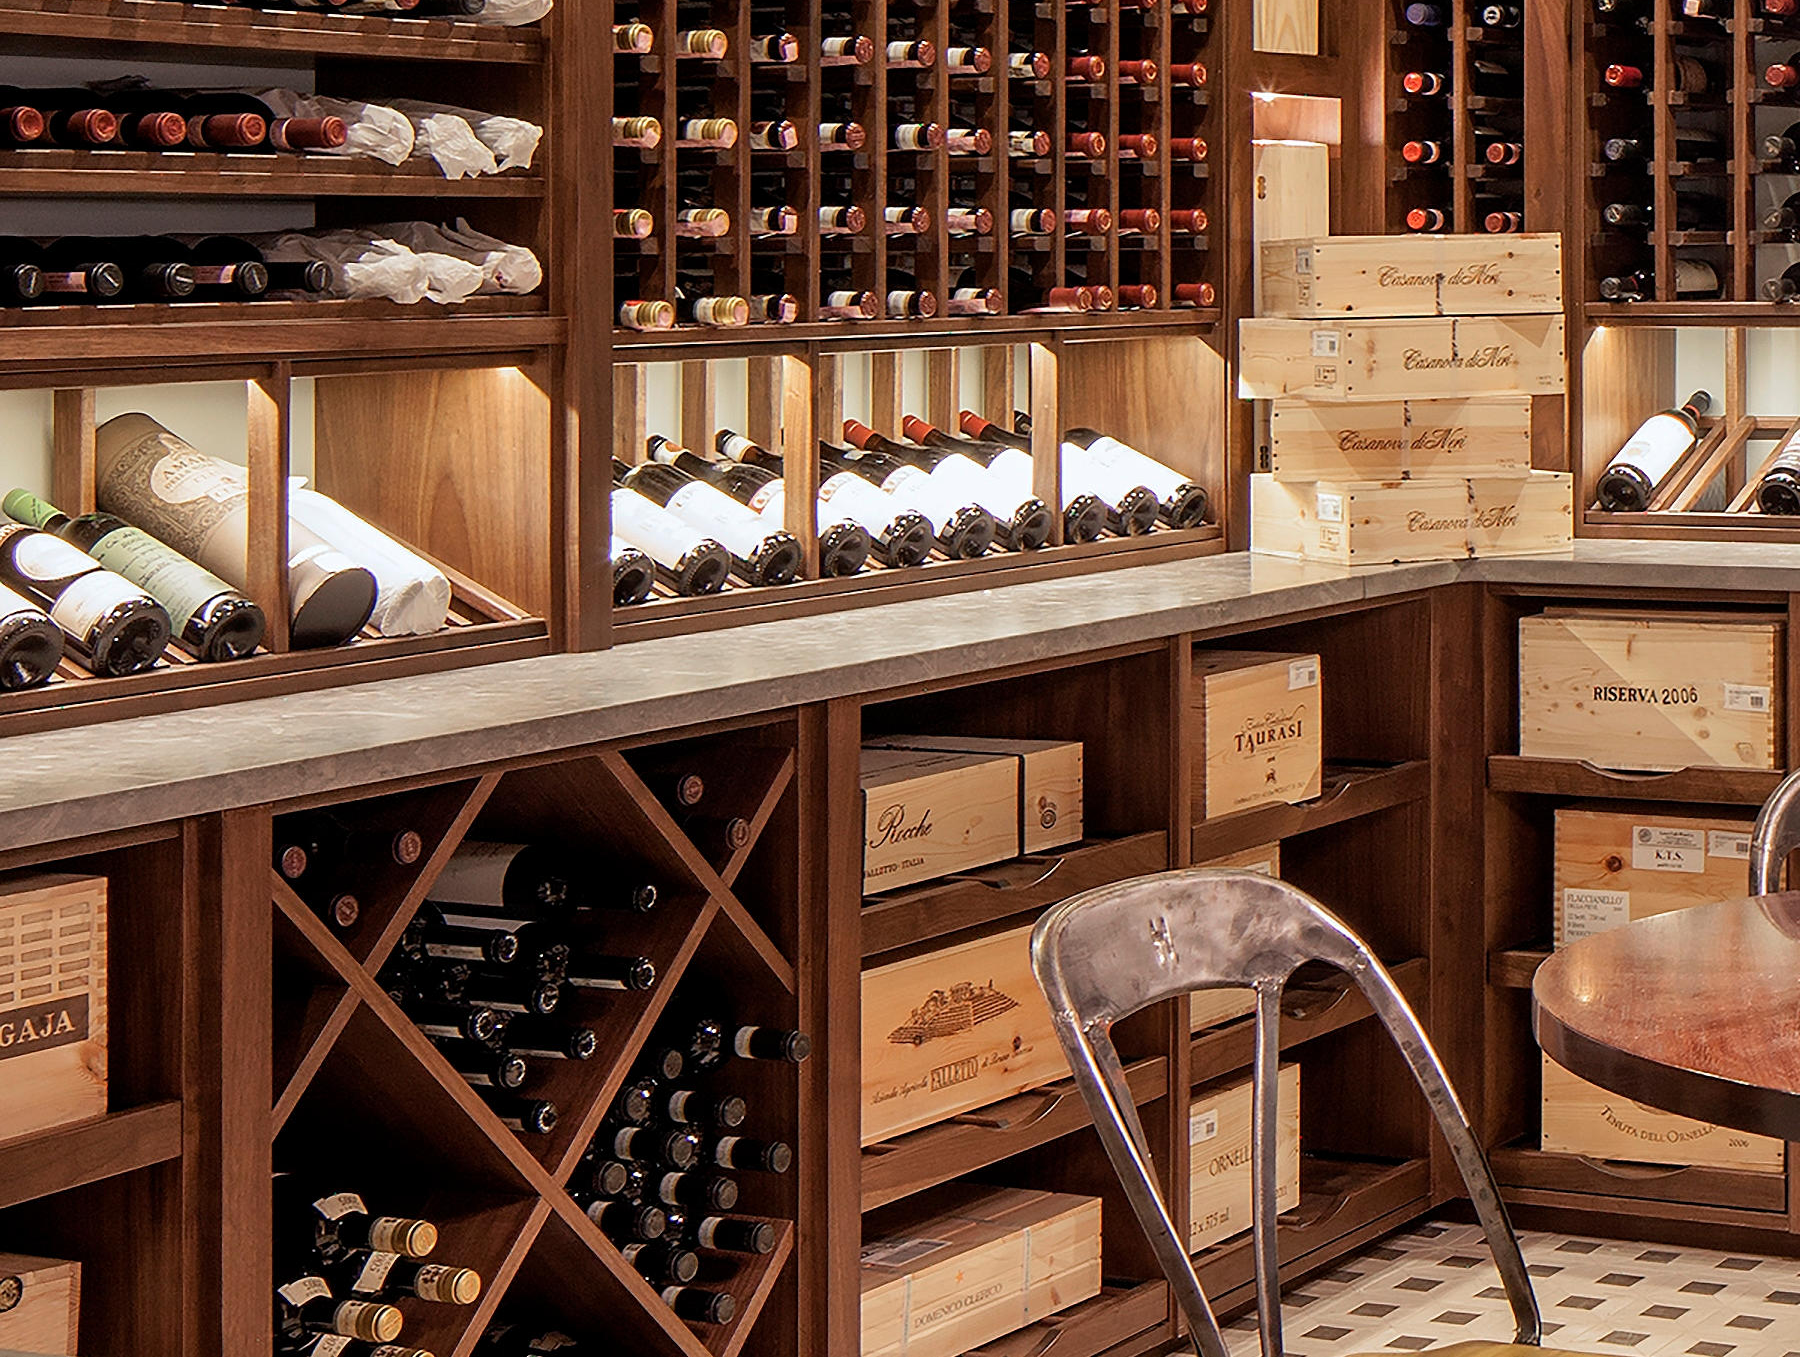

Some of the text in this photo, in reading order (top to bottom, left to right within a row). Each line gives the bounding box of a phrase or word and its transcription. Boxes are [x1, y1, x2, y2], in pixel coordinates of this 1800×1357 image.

[1377, 264, 1446, 287] Casanov
[1592, 686, 1699, 705] RISERVA 2006
[1234, 719, 1302, 754] TAURASI
[866, 863, 898, 878] ALLETTO
[0, 1010, 76, 1047] GAJA
[1600, 1104, 1638, 1138] TENUTA
[1208, 1145, 1253, 1177] ORNELL
[914, 1282, 1003, 1329] DOMENICO CLERICO
